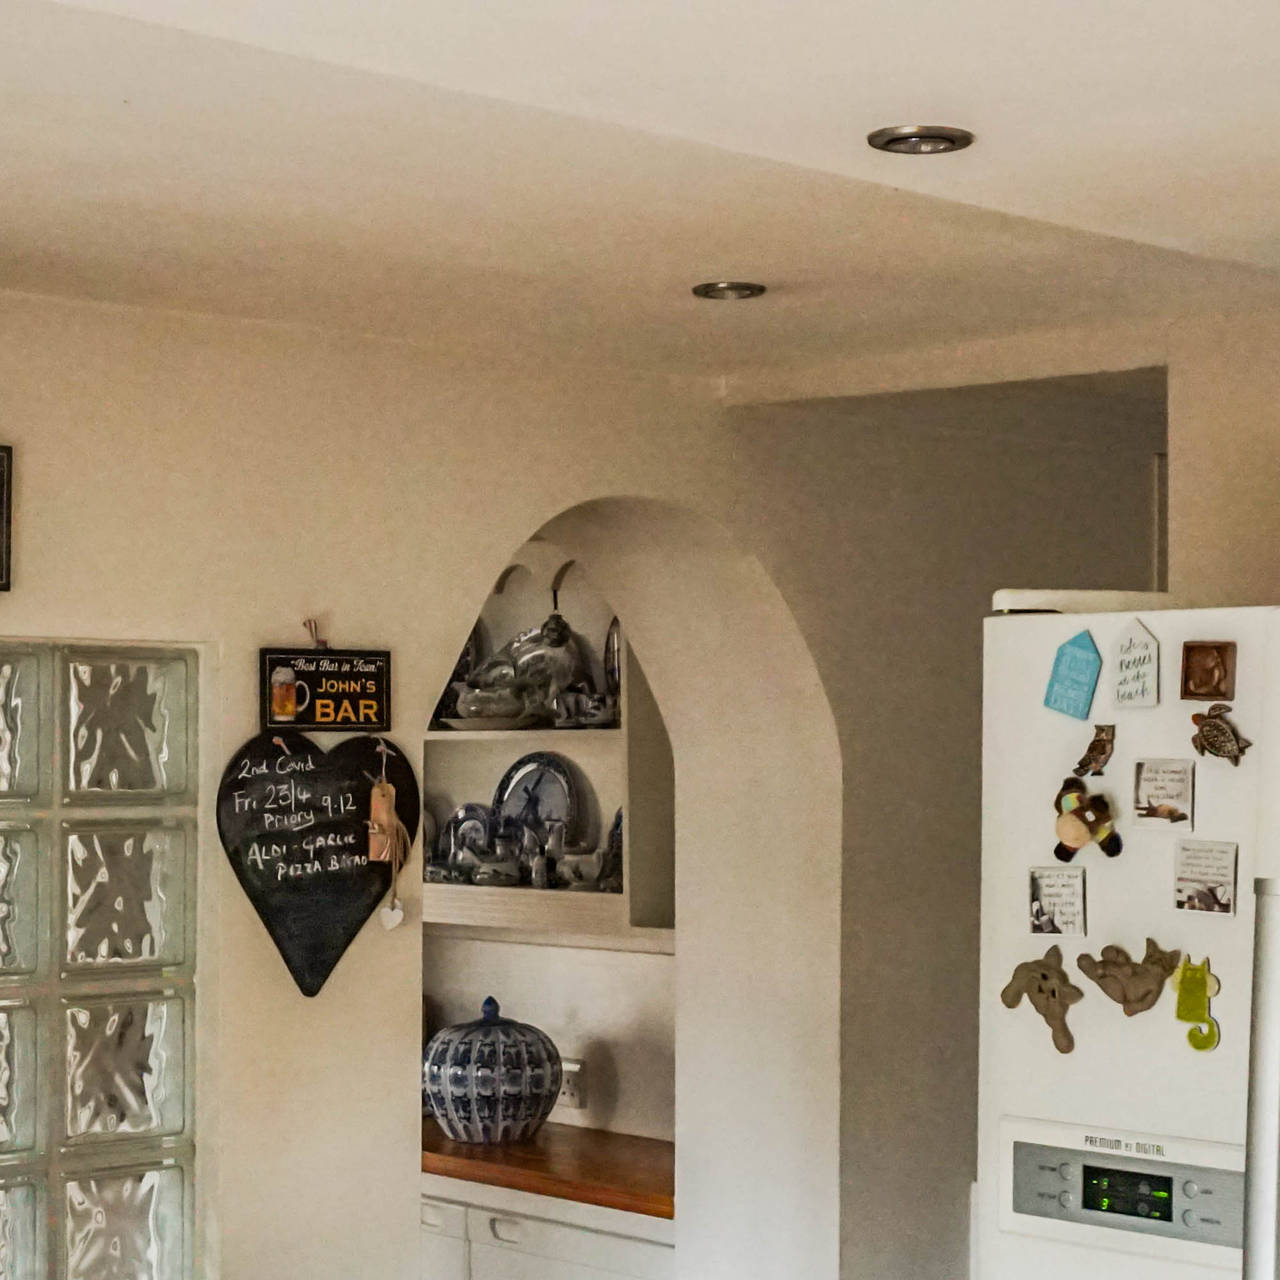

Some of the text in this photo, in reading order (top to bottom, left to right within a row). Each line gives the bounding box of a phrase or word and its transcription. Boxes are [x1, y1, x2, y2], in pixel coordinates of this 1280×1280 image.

[319, 659, 339, 672] Bar
[341, 659, 352, 673] in
[316, 677, 377, 694] JOHN'S
[315, 698, 379, 722] BAR
[237, 754, 316, 779] 2nd Covid
[263, 779, 312, 813] 23/4
[246, 842, 287, 870] ALDI
[275, 860, 322, 881] PIZZA
